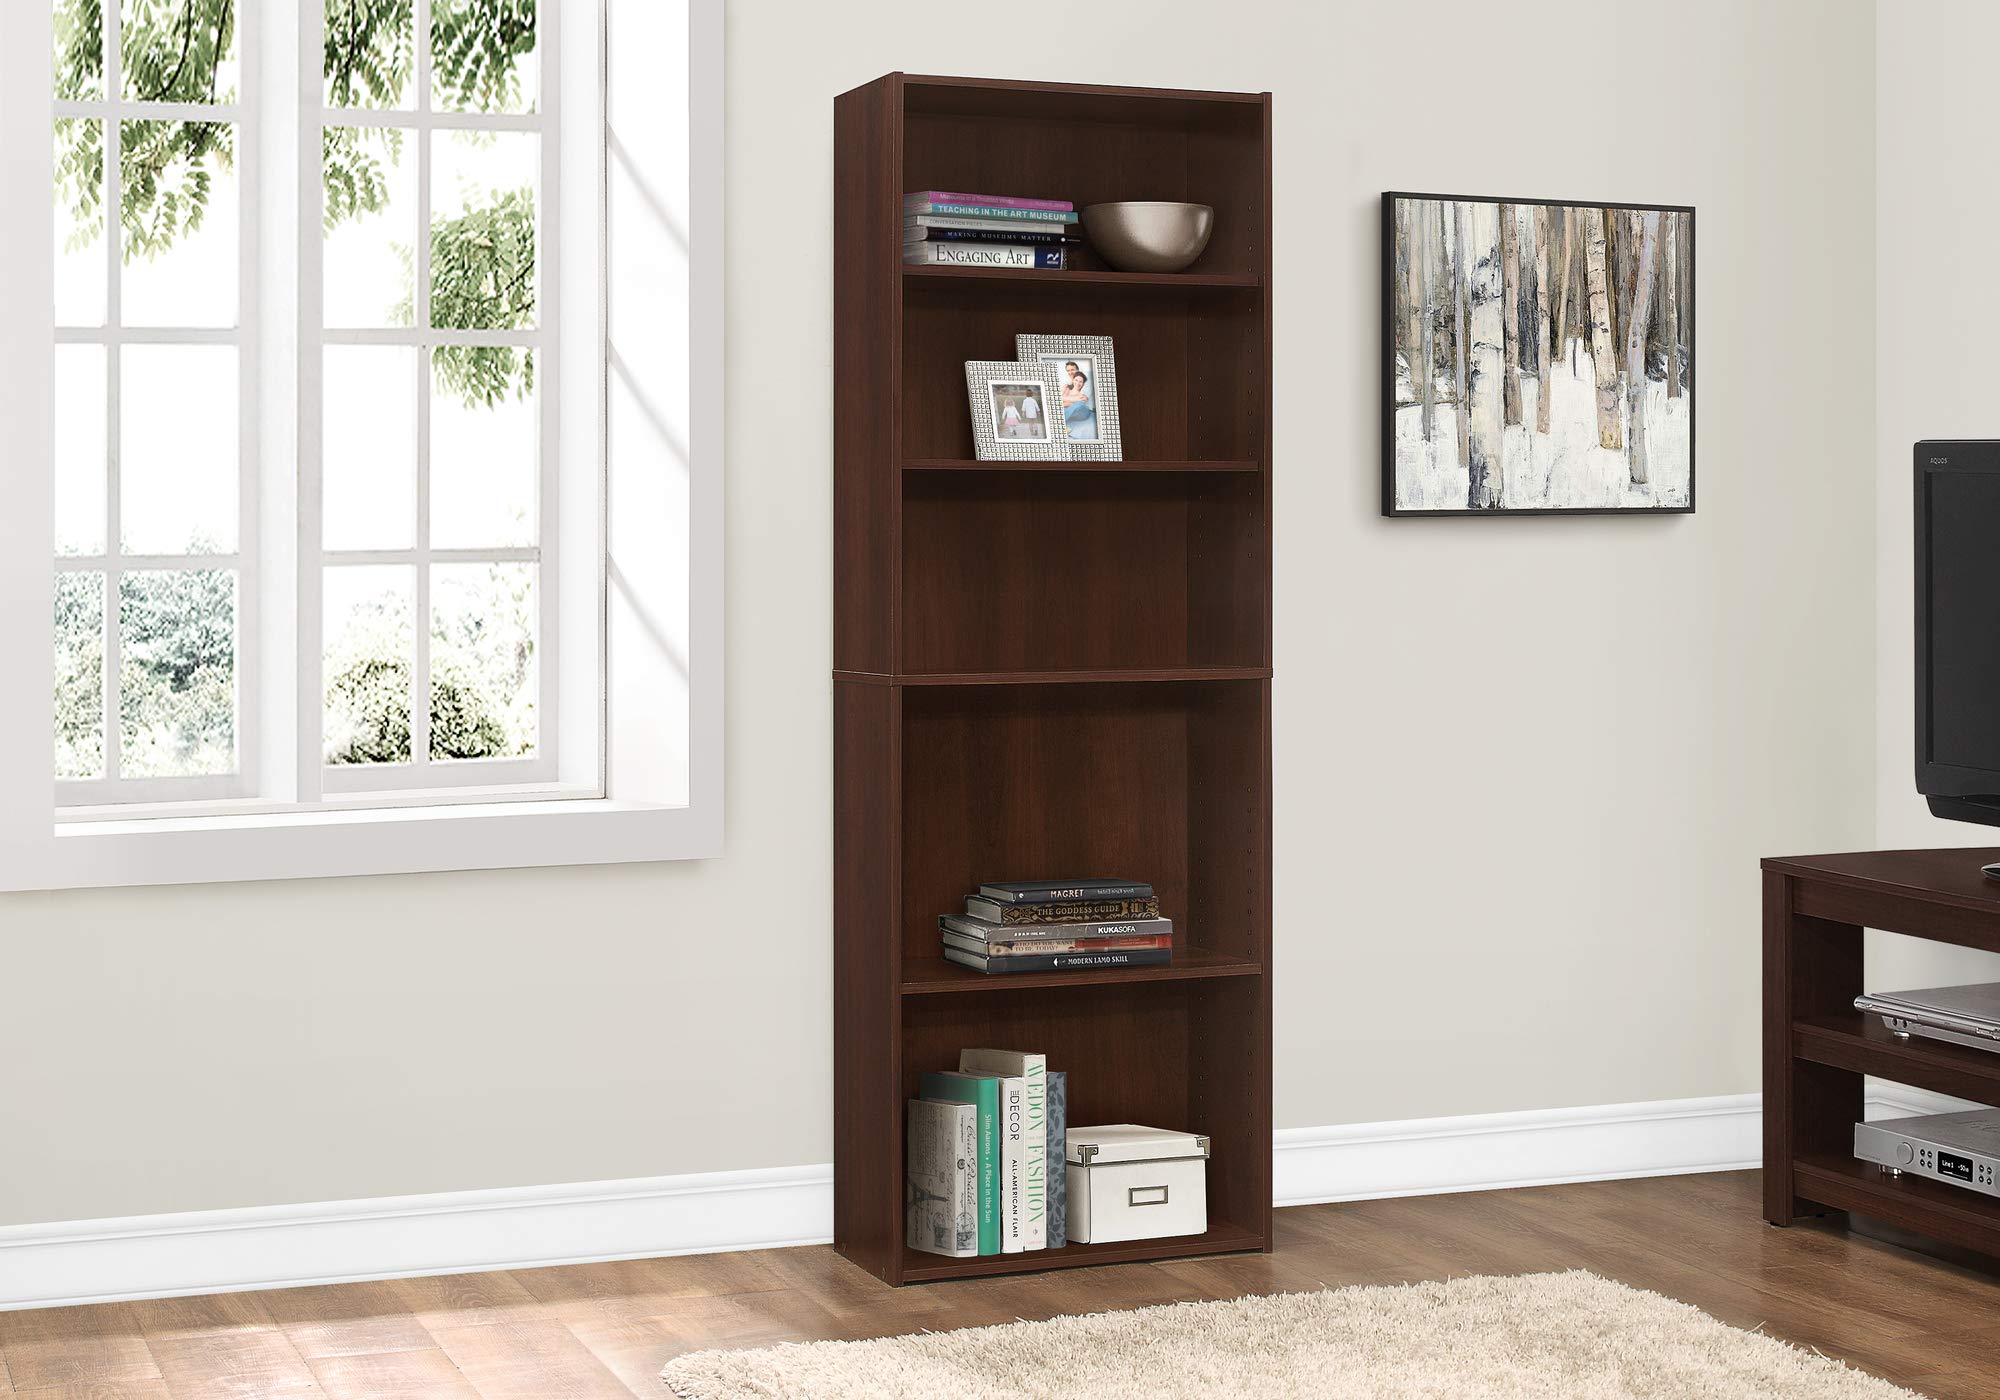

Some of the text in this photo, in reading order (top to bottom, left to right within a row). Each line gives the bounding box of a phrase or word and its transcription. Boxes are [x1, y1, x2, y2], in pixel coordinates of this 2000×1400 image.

[938, 205, 1067, 221] TEACHING IN THE ART MUSEUM
[936, 244, 1030, 265] ENGAGING ART
[1050, 889, 1085, 898] MAGRET
[1037, 905, 1120, 916] THE GODDESS GUIDE
[1097, 925, 1136, 934] KUKASOFA
[1067, 957, 1093, 965] MODERN
[1111, 955, 1128, 963] SKILL
[1028, 1064, 1044, 1130] AVEDON
[1010, 1095, 1020, 1141] DECOR
[1028, 1145, 1044, 1222] FASHION
